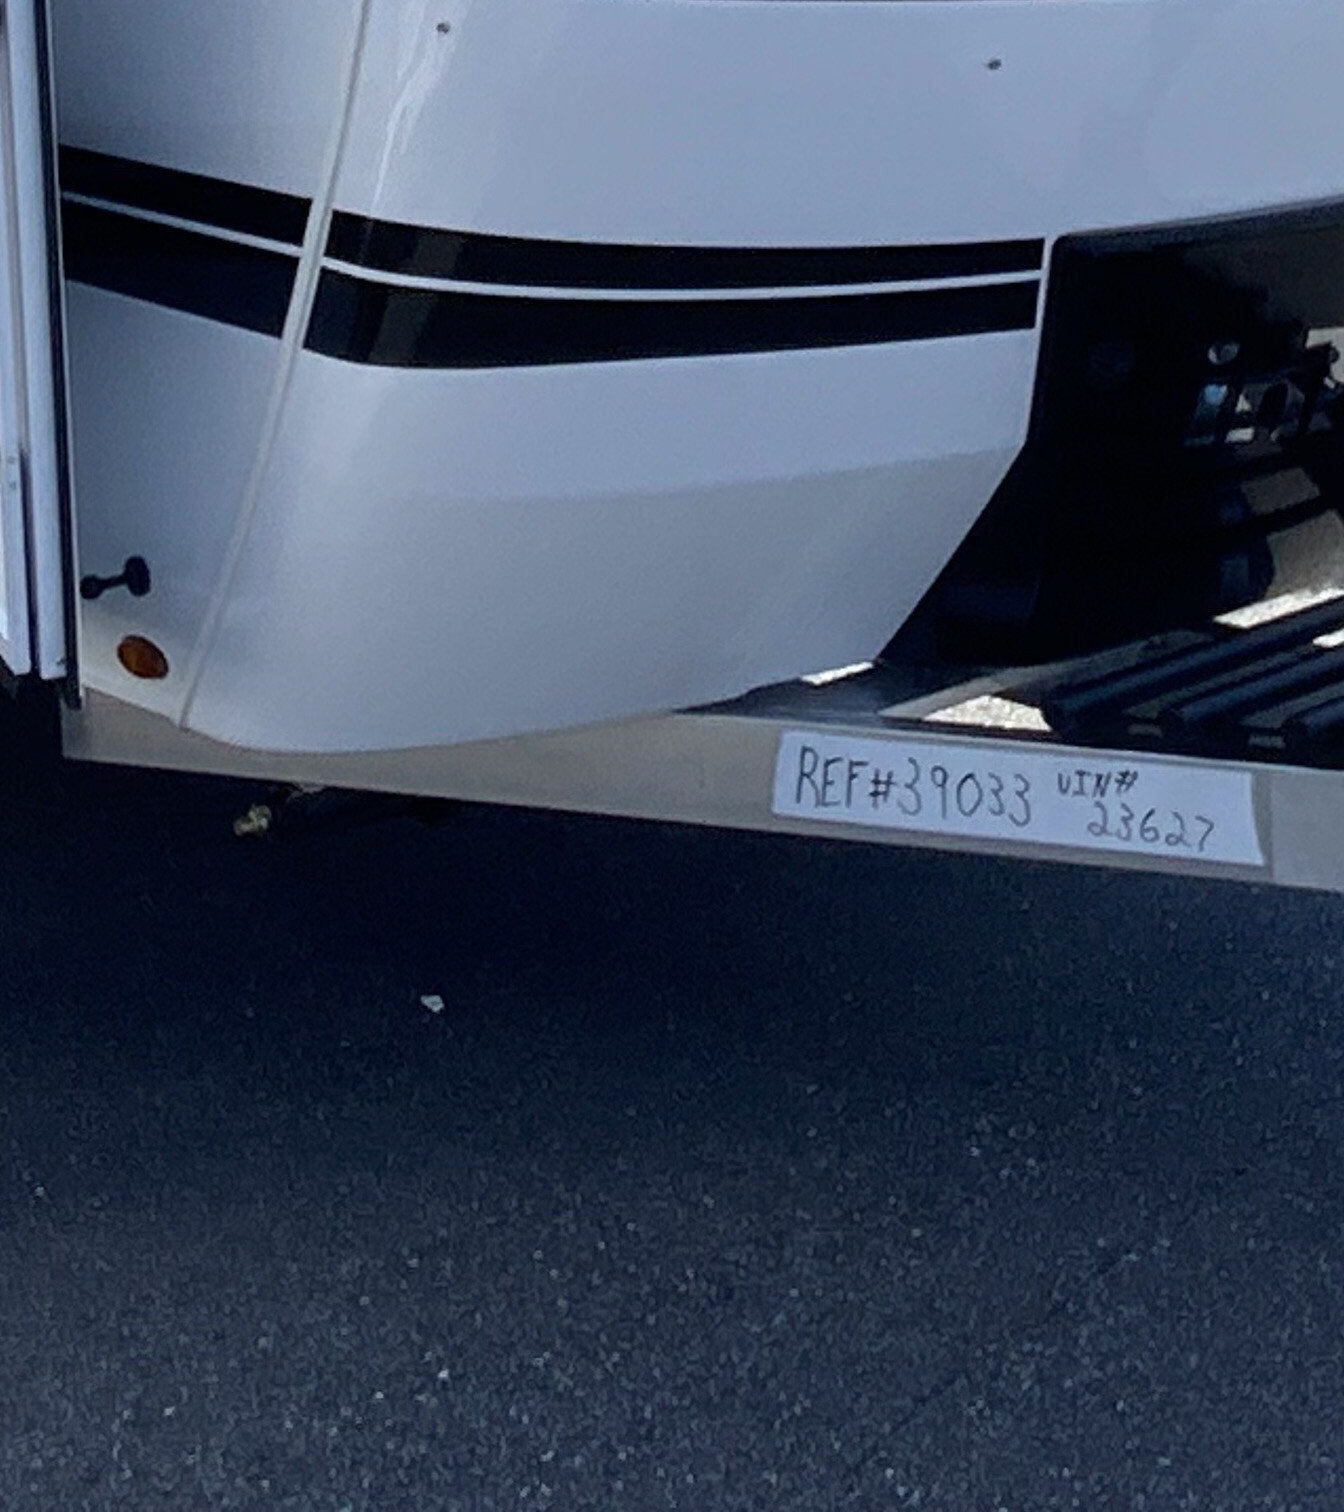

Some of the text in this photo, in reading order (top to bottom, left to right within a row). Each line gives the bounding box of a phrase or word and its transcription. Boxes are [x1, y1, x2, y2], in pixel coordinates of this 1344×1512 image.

[795, 745, 1139, 828] REF#39033 VIN#
[1087, 801, 1215, 853] 23627
